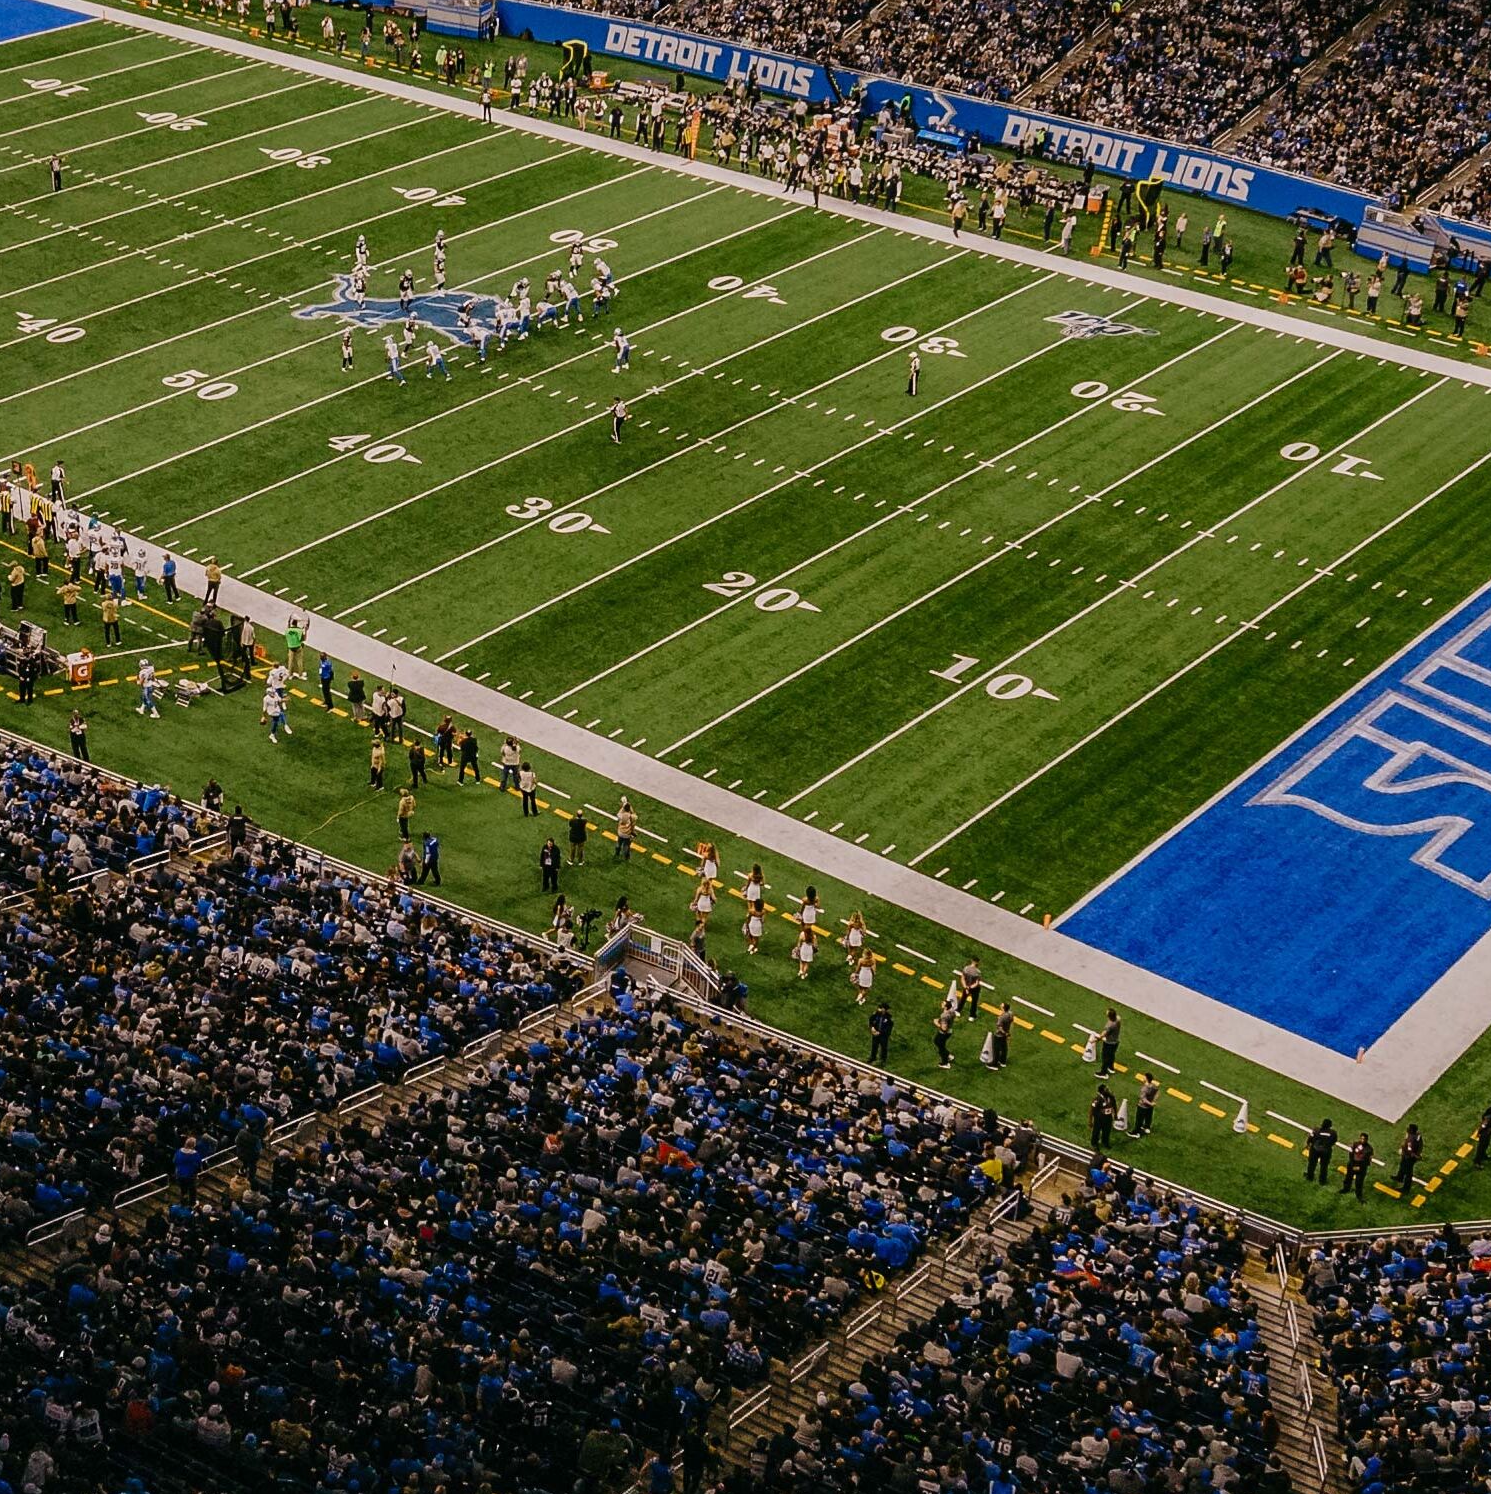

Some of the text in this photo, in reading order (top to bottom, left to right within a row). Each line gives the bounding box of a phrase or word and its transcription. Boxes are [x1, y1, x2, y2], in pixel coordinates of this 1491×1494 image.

[605, 22, 816, 98] DETROIT LIONS
[36, 78, 88, 98] 10
[147, 111, 208, 132] 20
[269, 147, 332, 170] 30
[1001, 113, 1256, 201] DETROIT LIONS
[403, 186, 466, 209] 40
[550, 229, 619, 251] 50
[708, 274, 786, 305] 40
[18, 313, 87, 345] 40
[881, 326, 961, 357] 30
[162, 369, 239, 402] 50
[1070, 381, 1158, 413] 20
[328, 433, 405, 465] 40
[1280, 442, 1373, 477] 10
[506, 496, 594, 536] 30
[703, 571, 801, 612] 20
[77, 665, 88, 677] G
[931, 653, 1035, 701] 10
